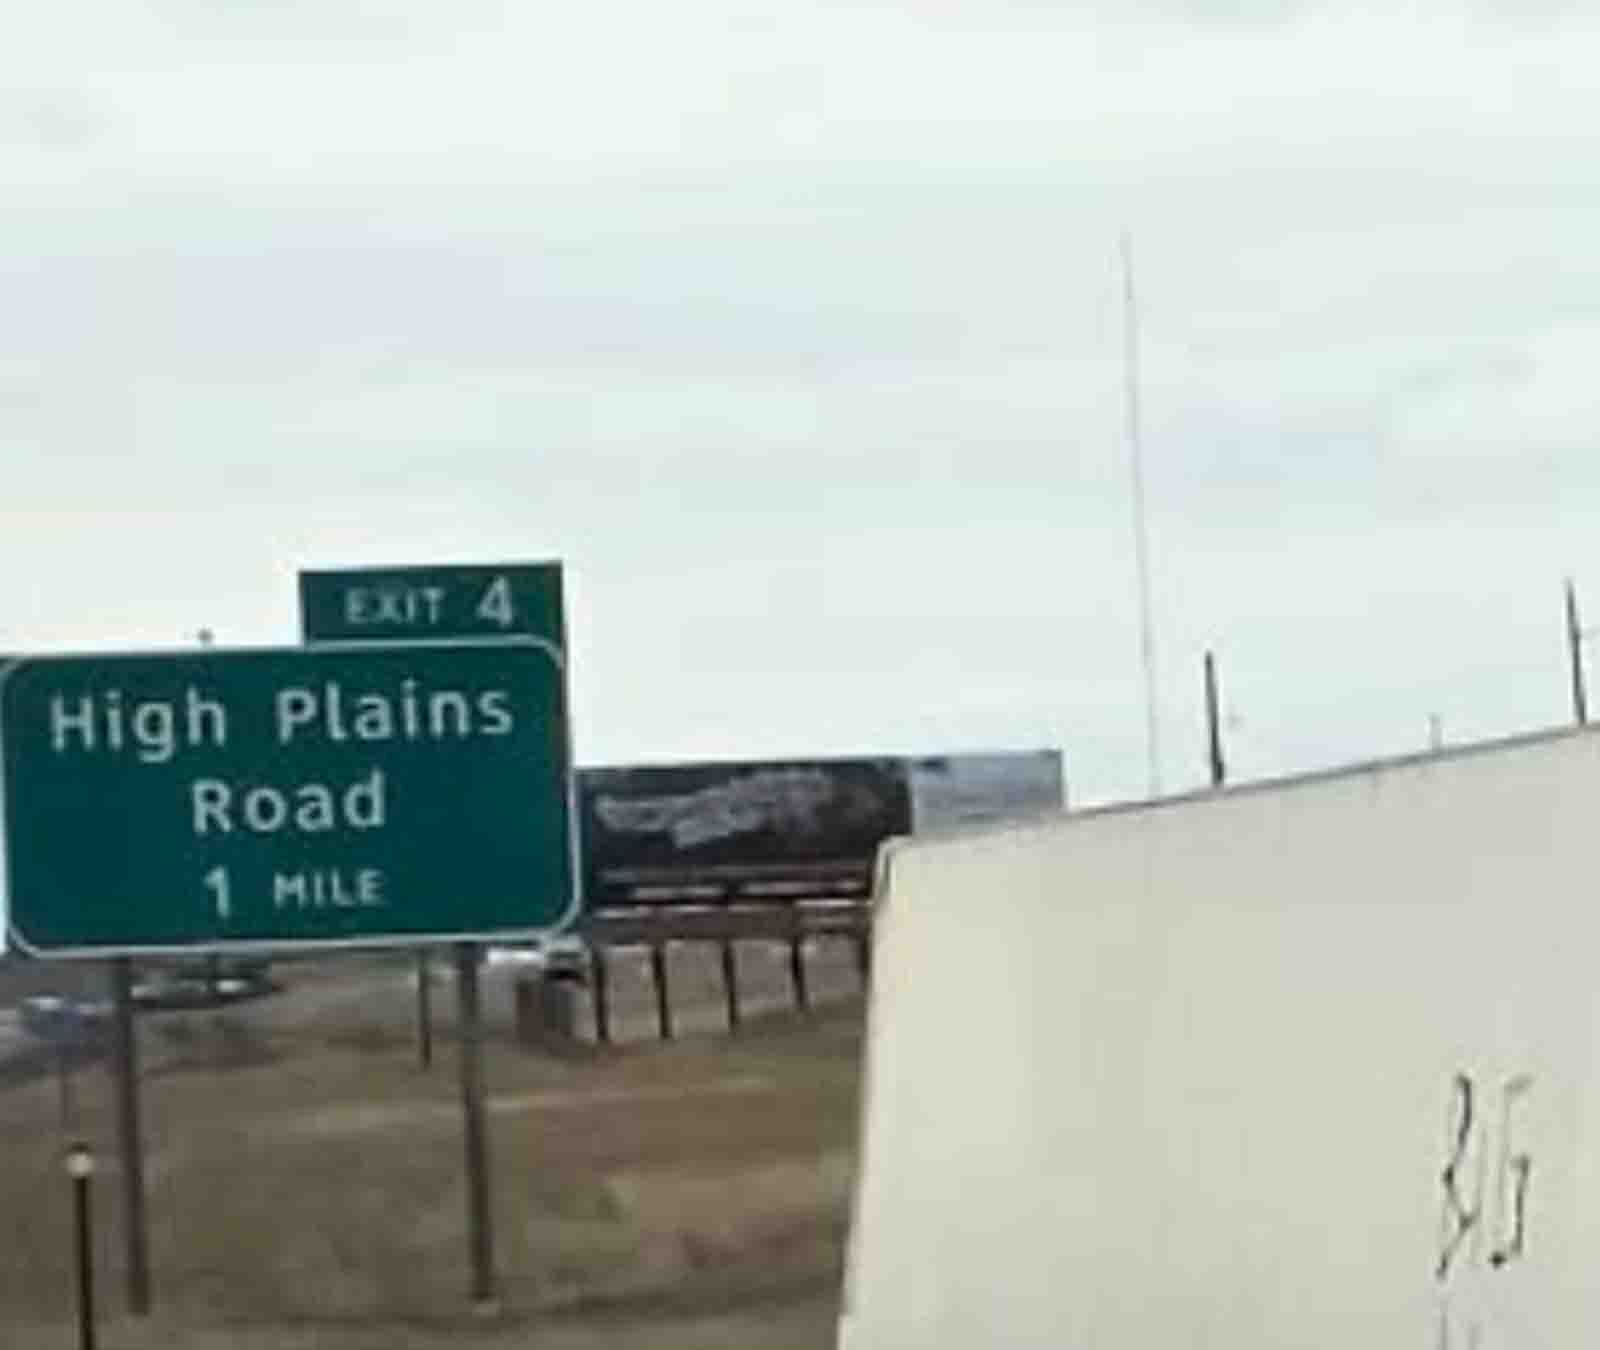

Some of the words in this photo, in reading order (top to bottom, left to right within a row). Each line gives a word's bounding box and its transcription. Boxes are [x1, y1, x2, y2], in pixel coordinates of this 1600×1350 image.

[344, 587, 445, 625] EXIT
[475, 576, 514, 627] 4
[49, 687, 227, 763] High
[274, 679, 514, 743] Plains
[191, 768, 387, 836] Road
[203, 865, 231, 918] 1
[272, 869, 386, 909] MILE
